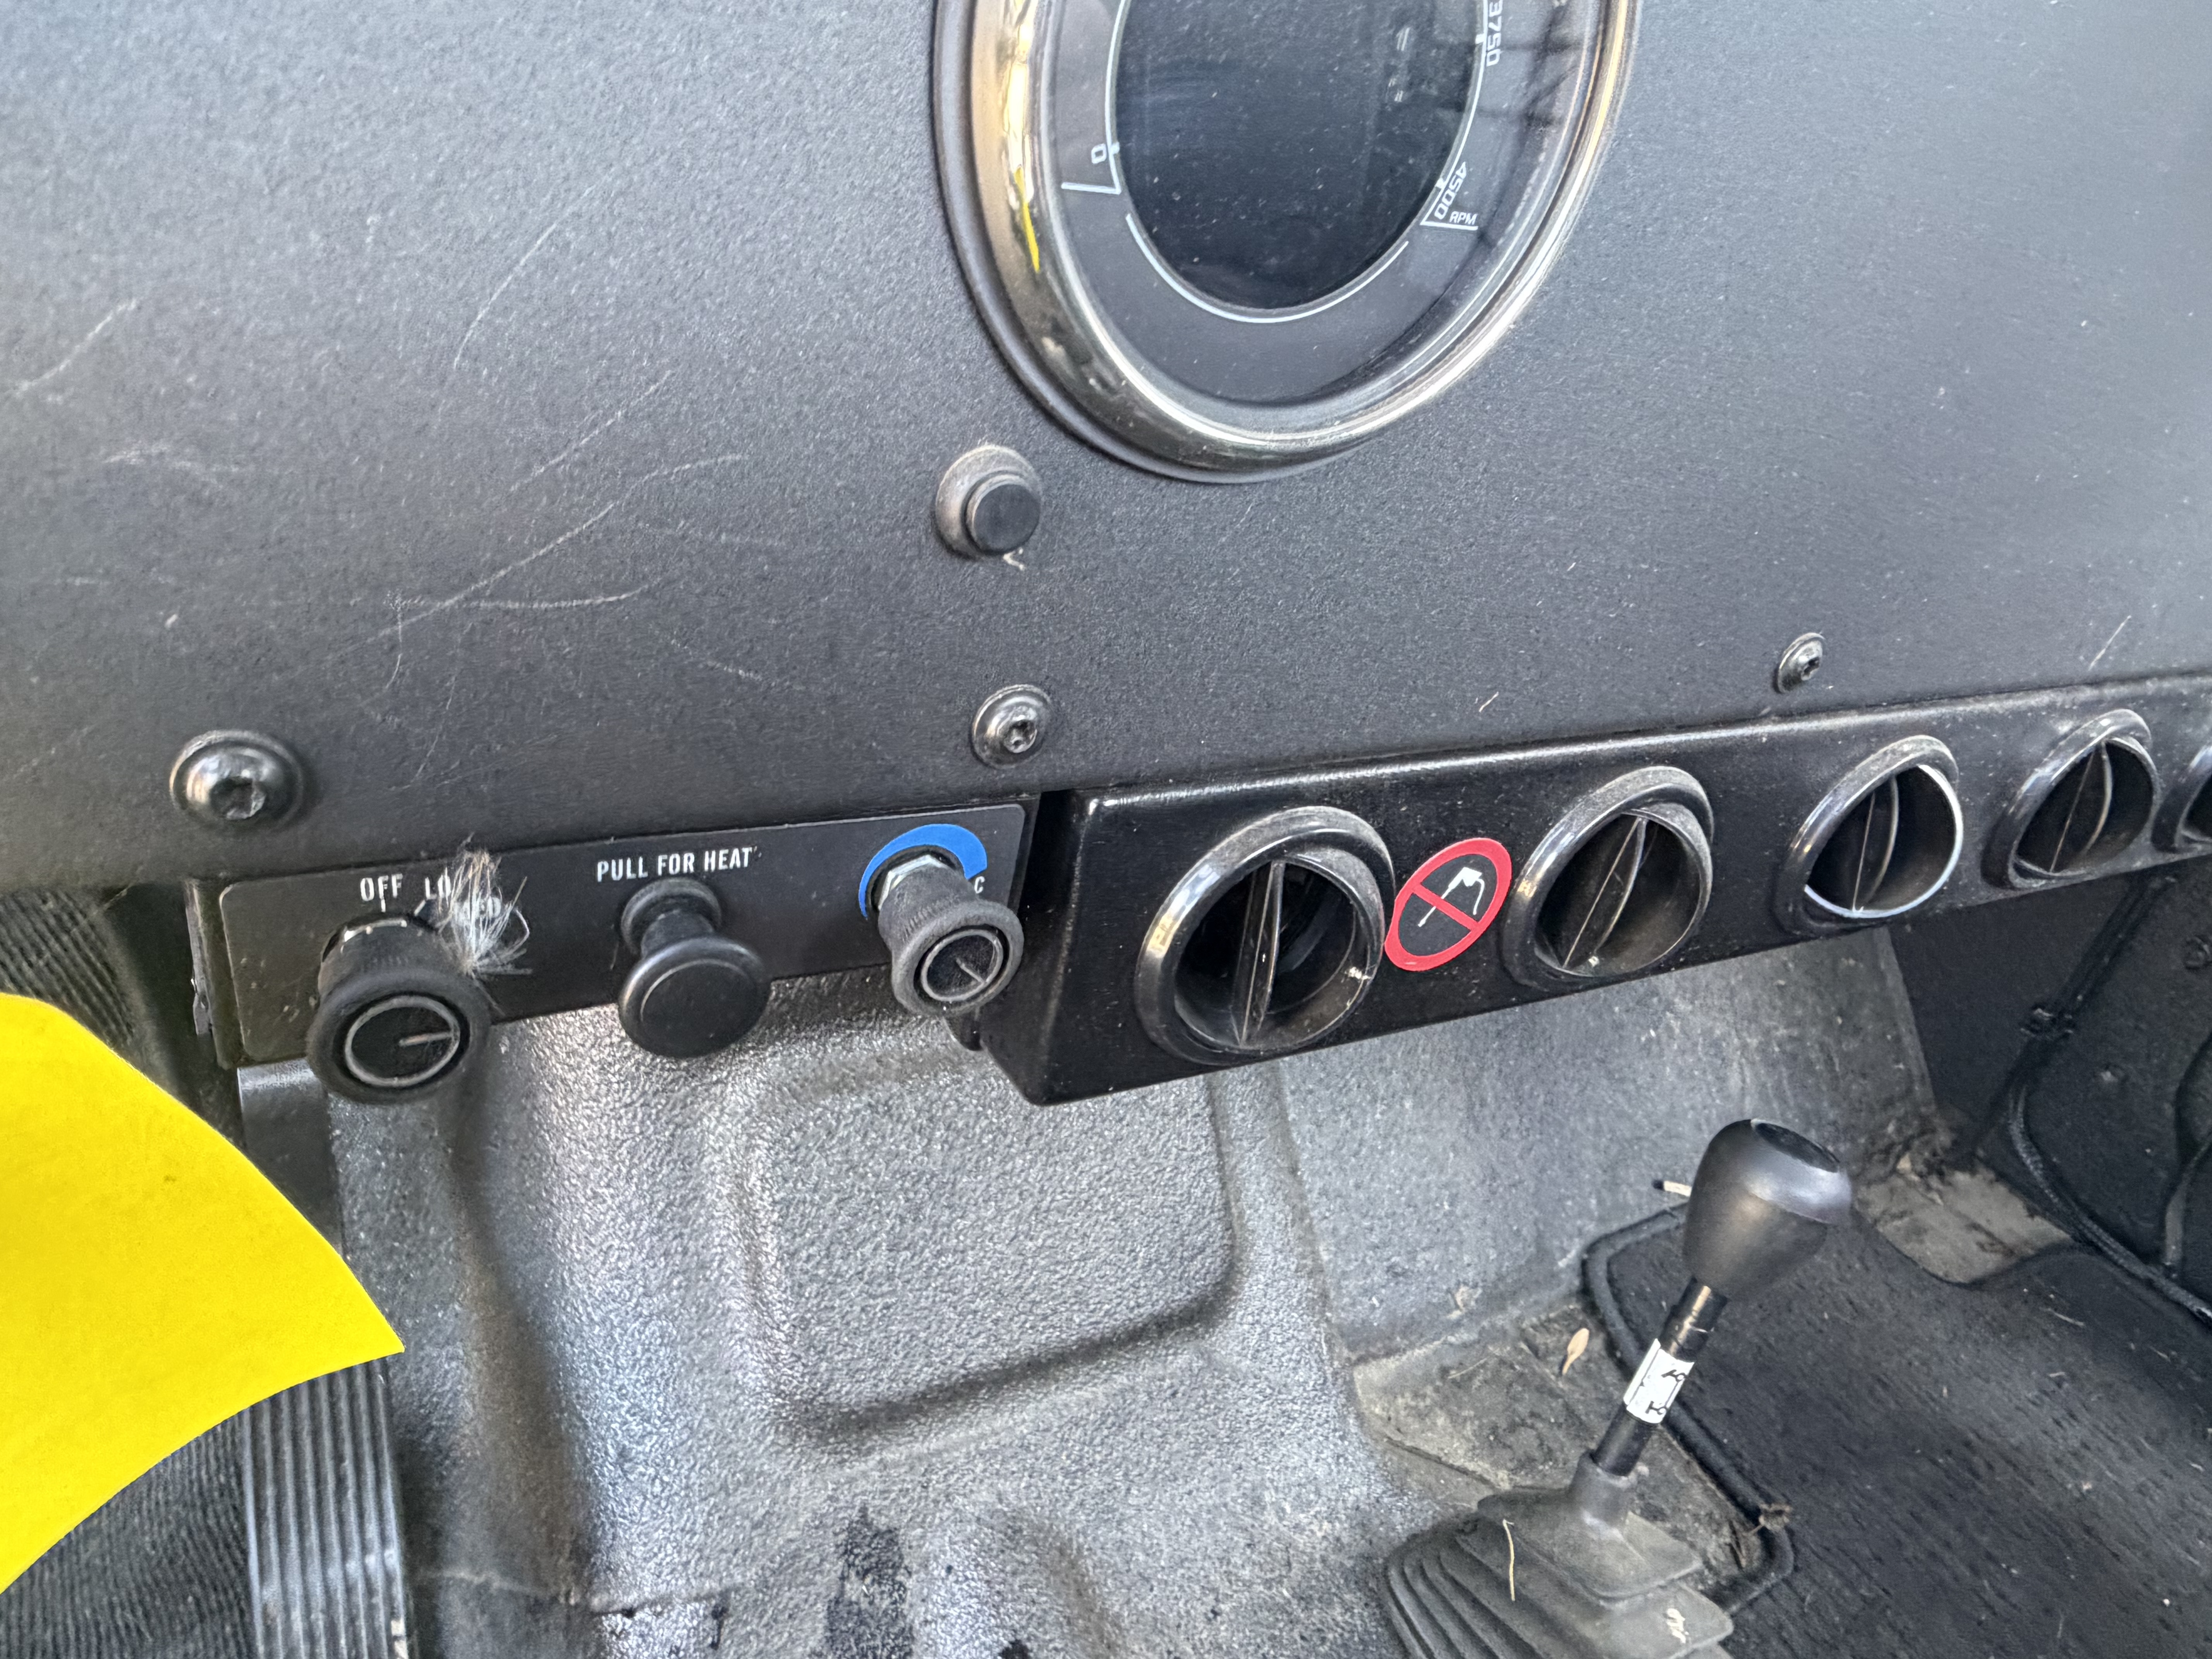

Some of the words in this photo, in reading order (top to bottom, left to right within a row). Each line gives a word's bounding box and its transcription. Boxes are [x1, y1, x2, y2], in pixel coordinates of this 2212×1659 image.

[1486, 0, 1503, 67] 3750
[1091, 143, 1107, 164] 0
[1434, 161, 1467, 220] 4500
[1449, 211, 1479, 225] RPM
[597, 855, 648, 883] PULL
[658, 852, 695, 876] FOR
[704, 847, 752, 872] HEAT
[360, 873, 403, 902] OFF
[974, 876, 985, 894] C
